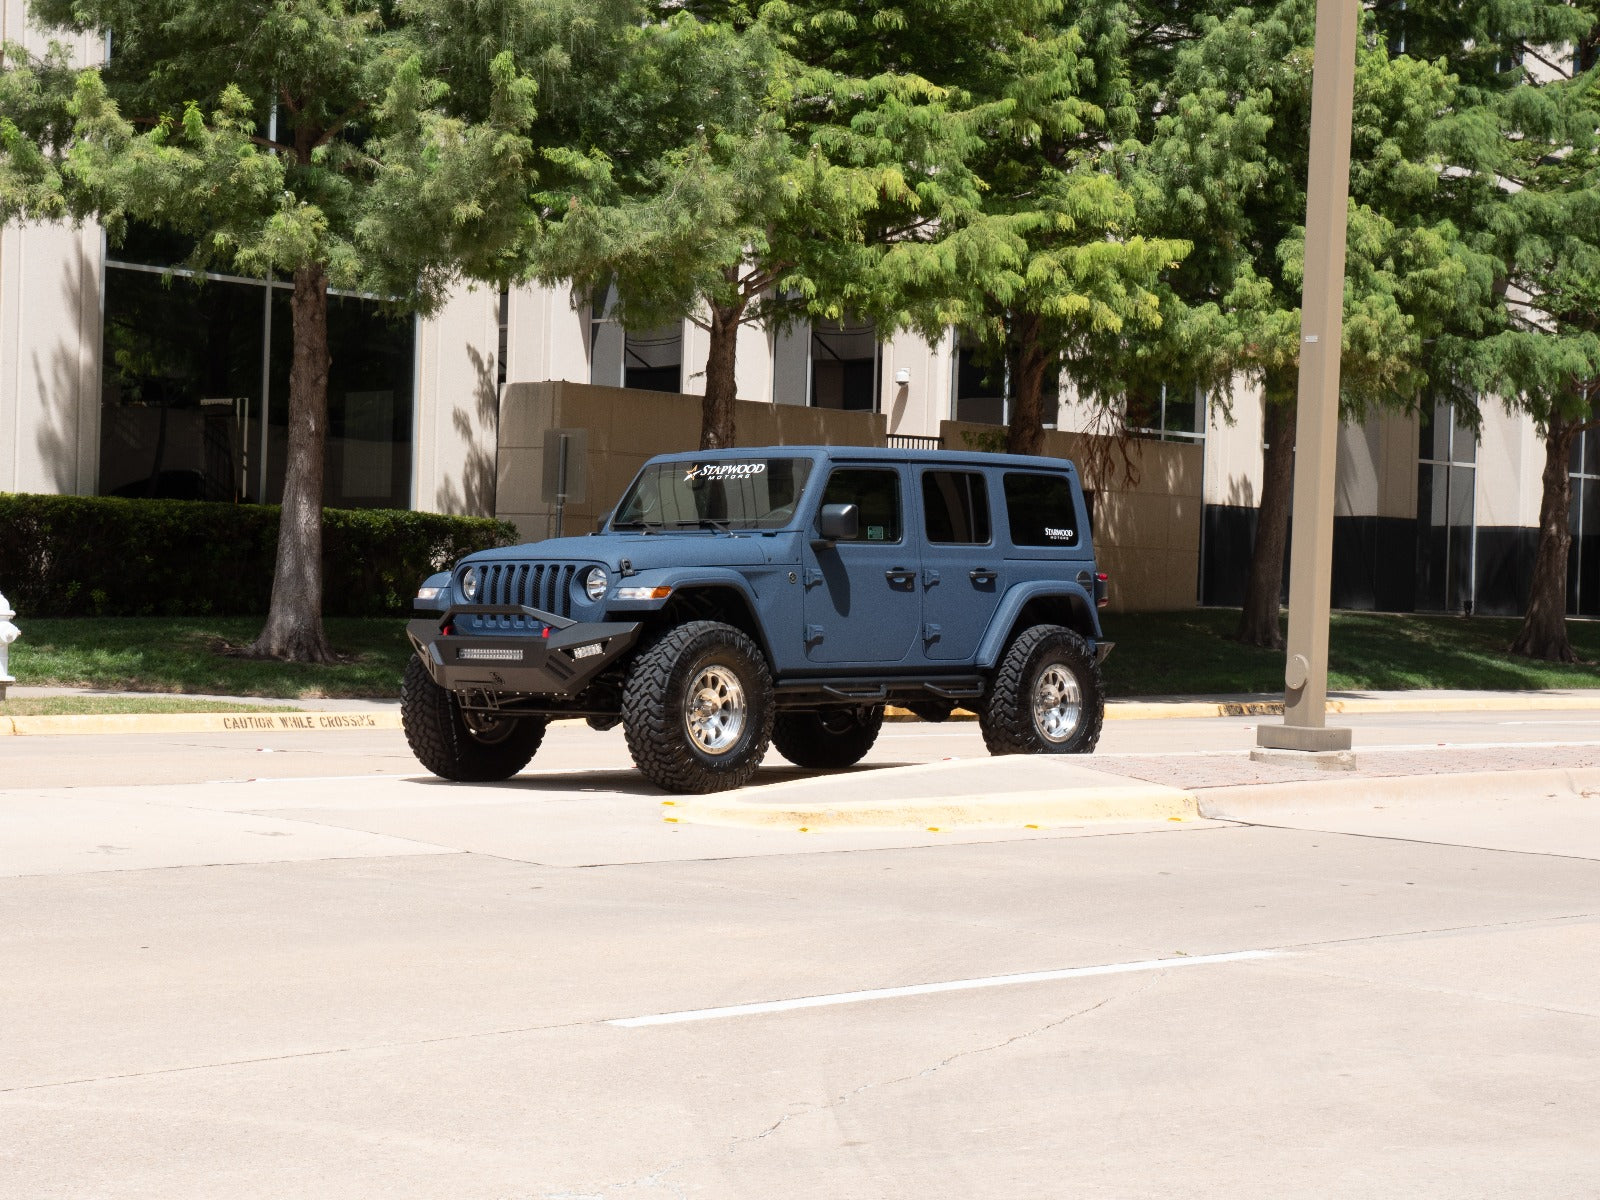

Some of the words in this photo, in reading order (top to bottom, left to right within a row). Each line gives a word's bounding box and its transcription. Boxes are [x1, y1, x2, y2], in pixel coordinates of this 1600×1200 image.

[1044, 527, 1074, 537] STARWOOD
[223, 717, 275, 729] CAUTION
[279, 716, 315, 729] WHILE
